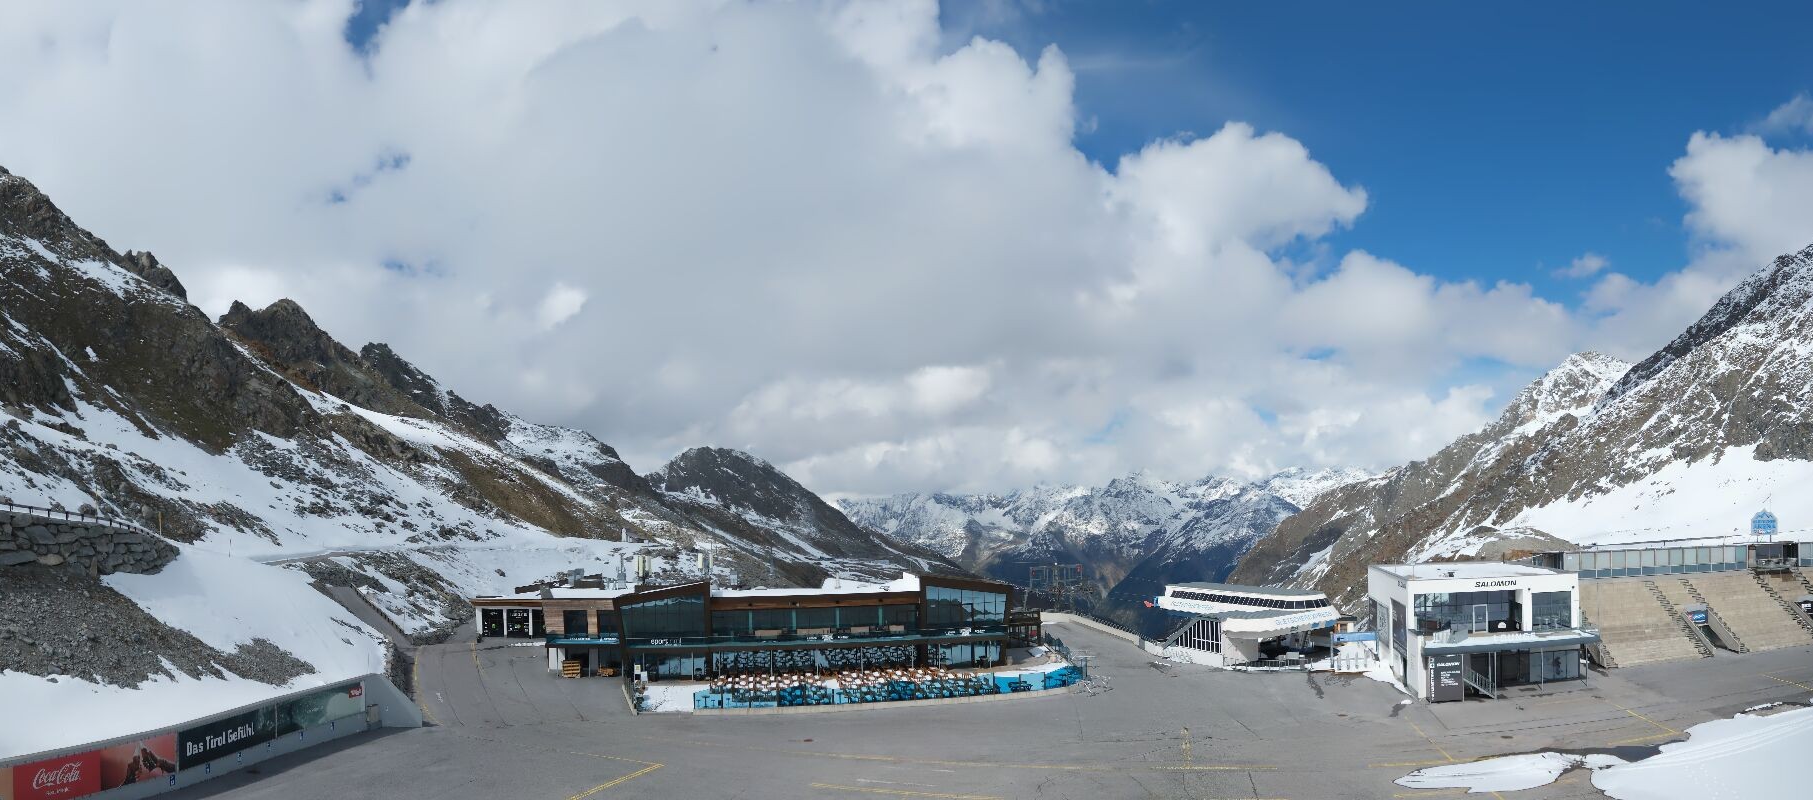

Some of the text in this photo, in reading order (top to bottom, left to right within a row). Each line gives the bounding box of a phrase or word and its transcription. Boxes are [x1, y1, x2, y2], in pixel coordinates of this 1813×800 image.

[1474, 580, 1517, 588] SALOMON
[186, 741, 204, 757] Das
[206, 731, 226, 750] Tirol
